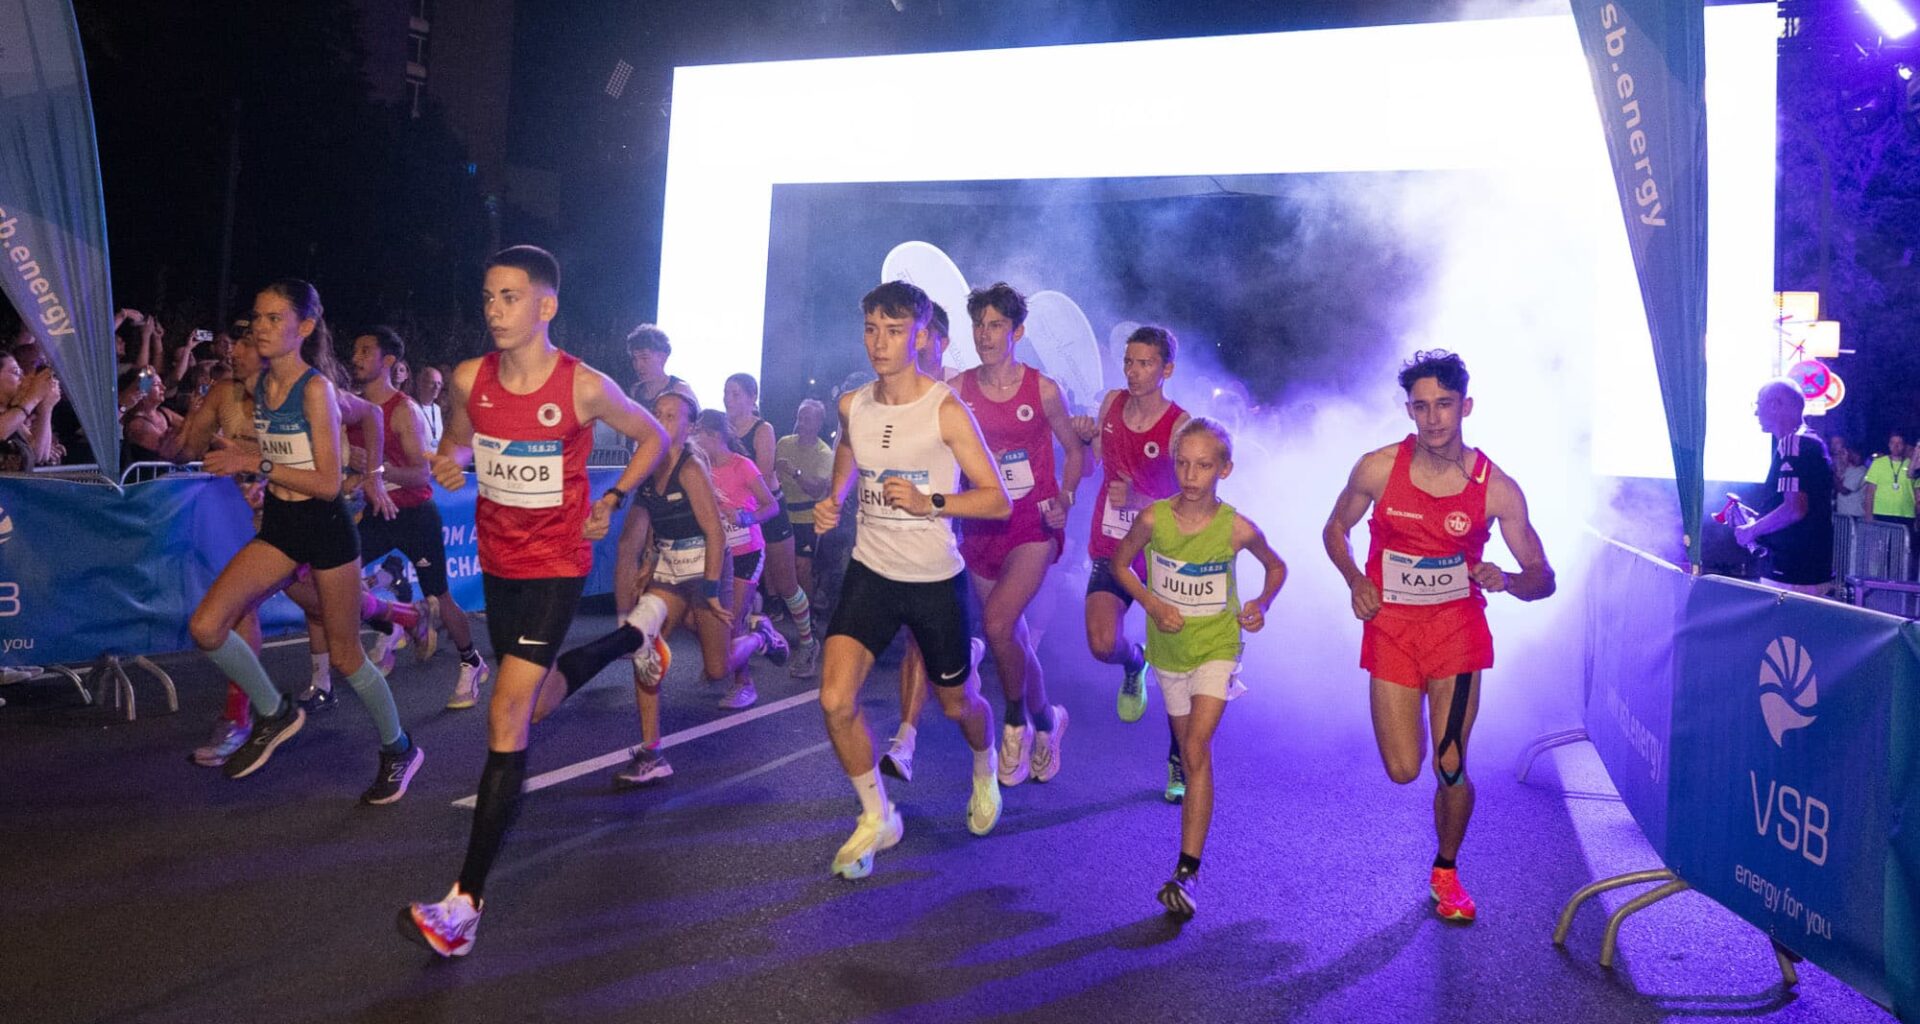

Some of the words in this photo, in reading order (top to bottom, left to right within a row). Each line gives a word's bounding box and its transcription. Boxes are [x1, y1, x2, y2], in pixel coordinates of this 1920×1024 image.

[0, 207, 76, 336] b.energy
[262, 440, 294, 455] ANNI
[527, 444, 557, 453] 15.8.25
[486, 461, 550, 482] JAKOB
[1162, 575, 1214, 596] JULIUS
[1401, 572, 1453, 587] KAJO
[3, 637, 35, 654] you
[1750, 769, 1830, 867] VSB
[1735, 864, 1782, 913] energy
[1782, 887, 1804, 921] for
[1806, 908, 1832, 940] you
